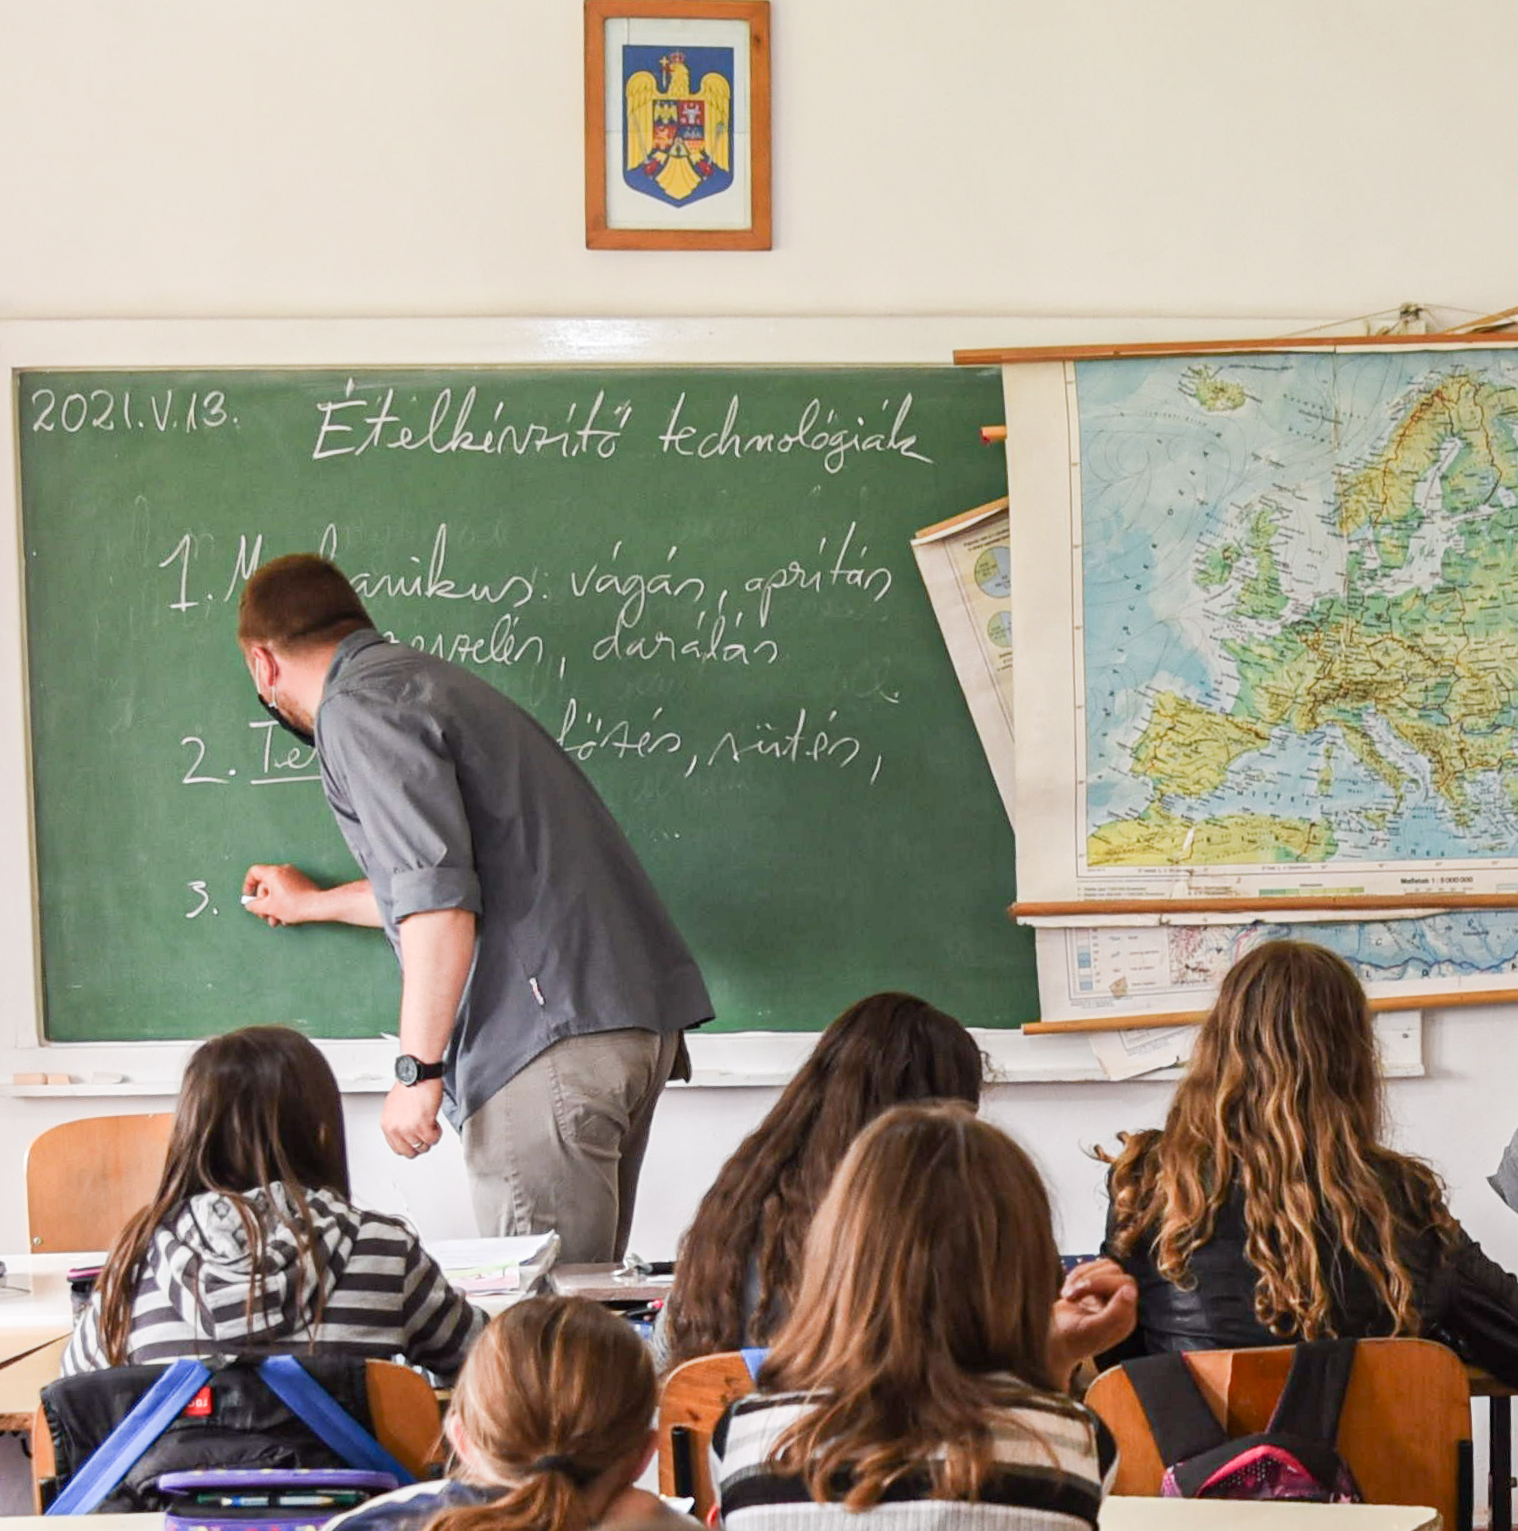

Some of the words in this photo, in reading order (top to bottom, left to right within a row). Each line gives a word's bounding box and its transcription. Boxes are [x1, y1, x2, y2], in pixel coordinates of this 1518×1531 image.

[658, 392, 935, 474] technológiák
[159, 533, 214, 613] 1.
[180, 736, 237, 784] 2.
[185, 880, 219, 919] 3.
